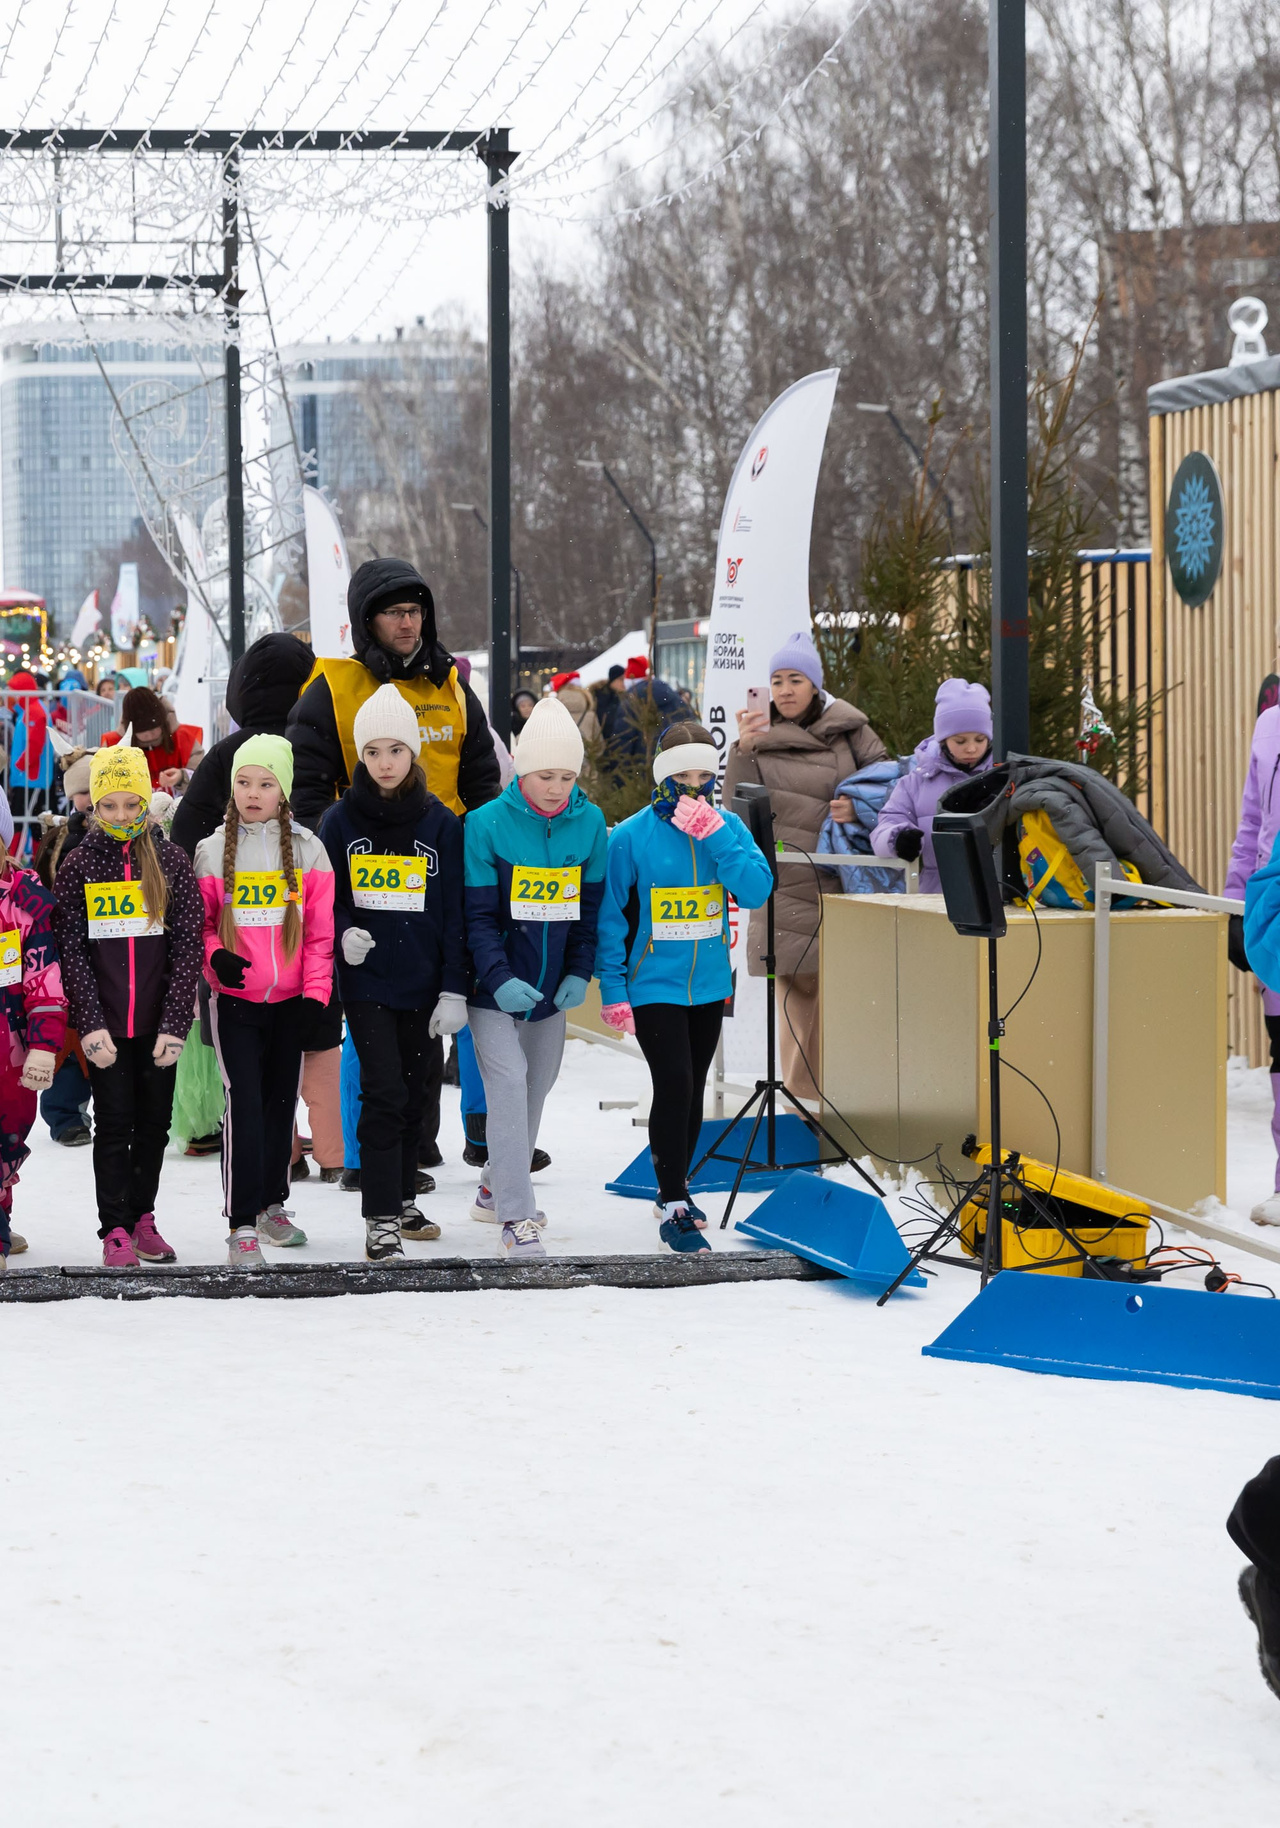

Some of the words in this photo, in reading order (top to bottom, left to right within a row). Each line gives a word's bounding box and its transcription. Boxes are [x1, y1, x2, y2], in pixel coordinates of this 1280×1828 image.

[714, 632, 738, 645] СПОРТ
[713, 645, 745, 658] НОРМА
[712, 657, 746, 671] ЖИЗНИ
[415, 704, 451, 712] АШНИКОВ
[416, 711, 426, 719] РТ
[418, 725, 454, 744] ДЬЯ
[358, 868, 401, 889] 268
[237, 885, 276, 905] 219
[517, 879, 559, 899] 229
[93, 895, 135, 917] 216
[659, 900, 699, 920] 212
